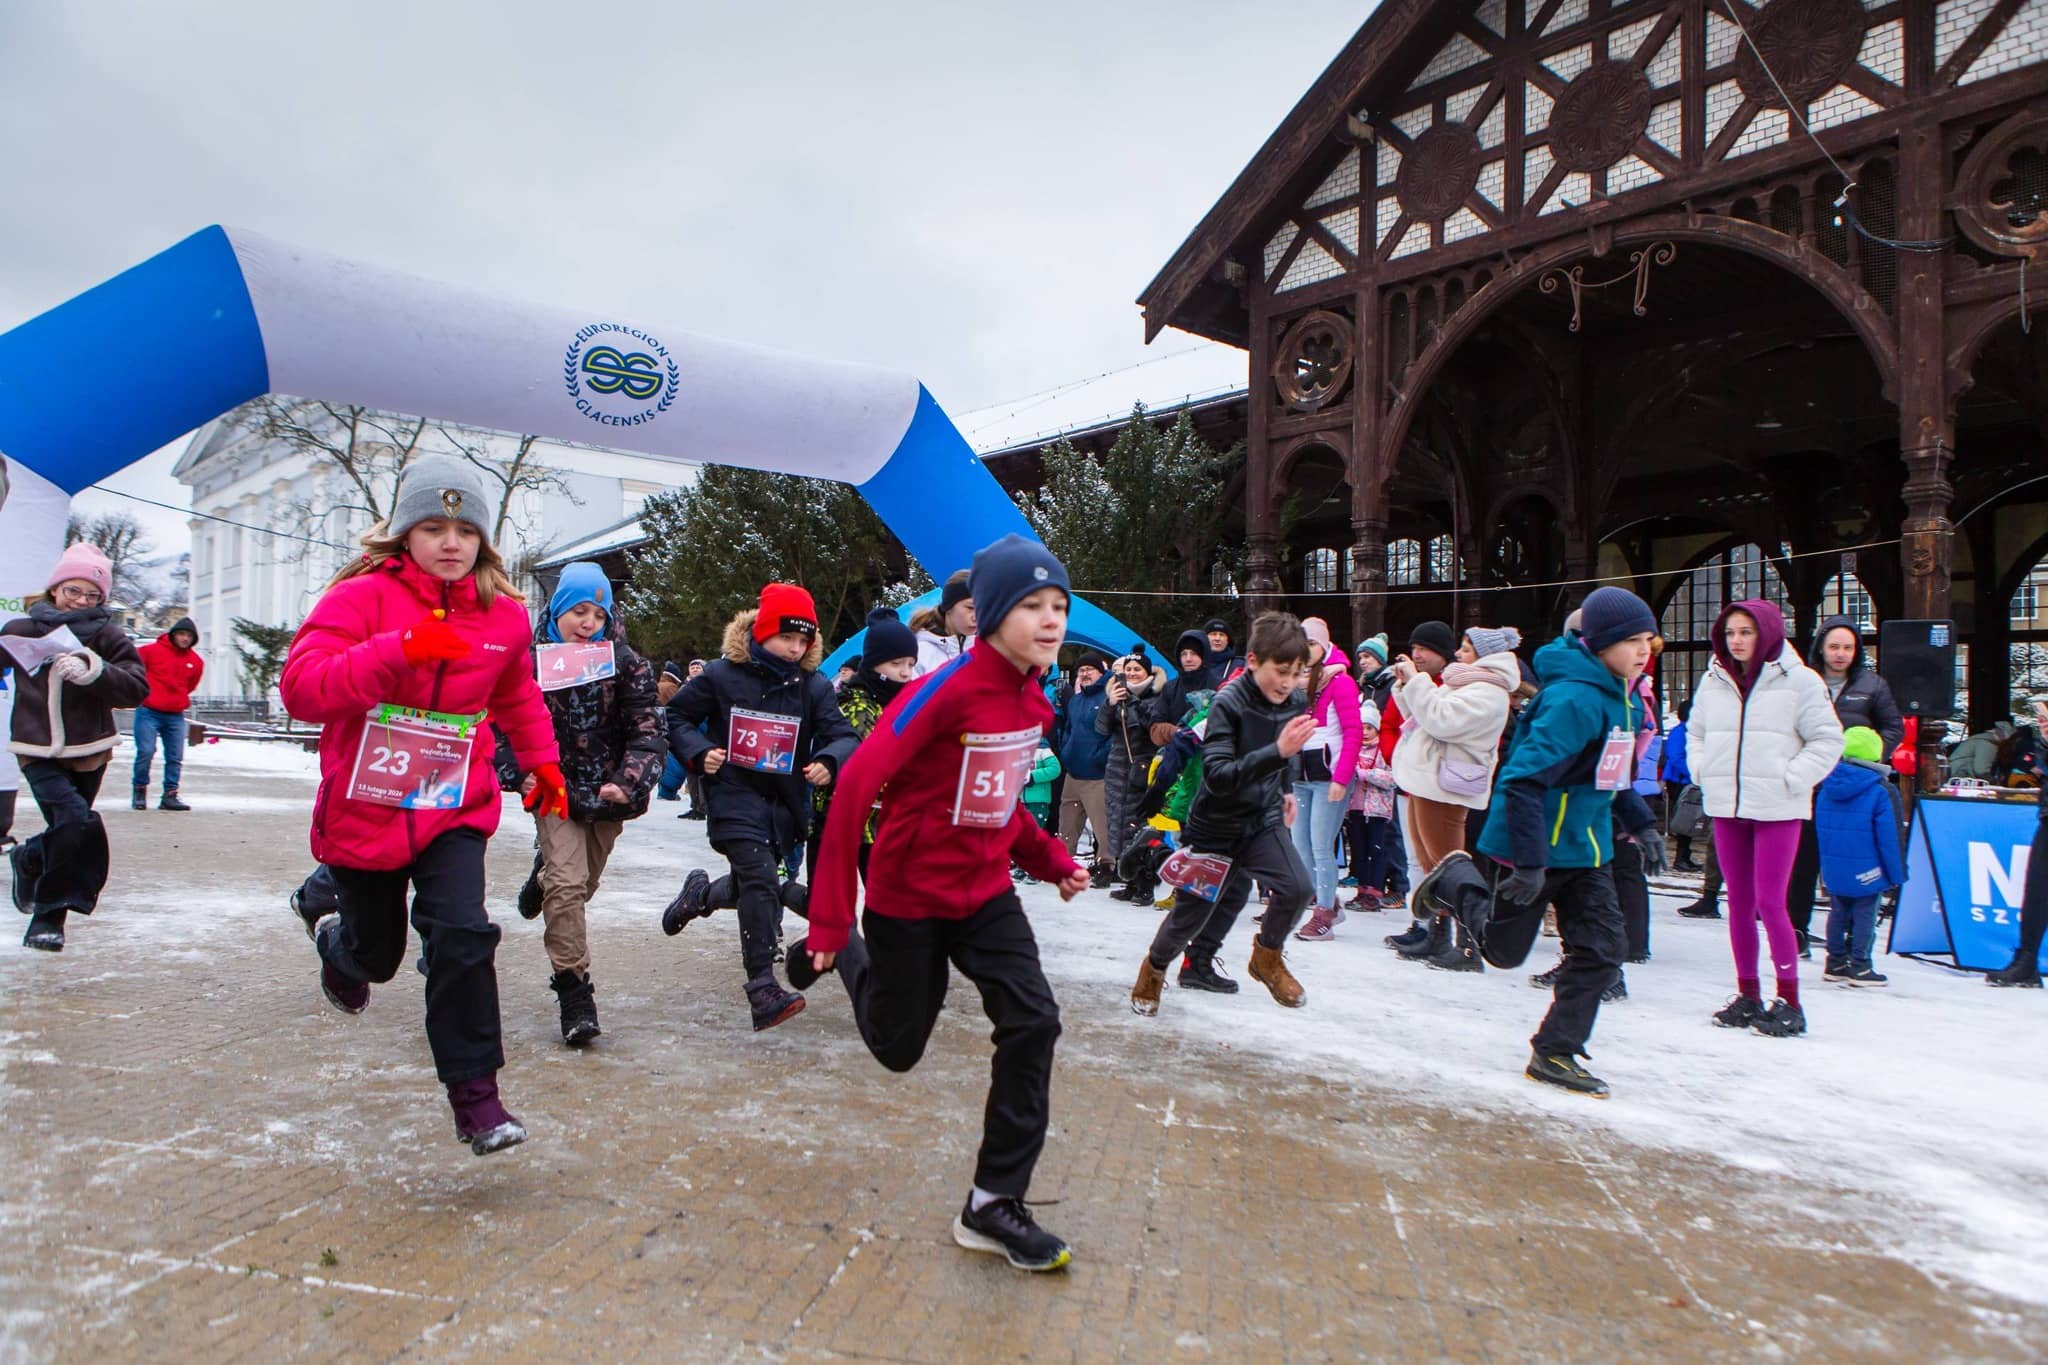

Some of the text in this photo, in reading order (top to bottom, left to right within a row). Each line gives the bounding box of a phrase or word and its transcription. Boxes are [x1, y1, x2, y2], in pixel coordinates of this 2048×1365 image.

[575, 323, 669, 357] EUROREGION
[575, 399, 656, 426] GLACENSIS
[552, 657, 566, 671] 4
[736, 728, 758, 748] 73
[368, 746, 411, 776] 23
[1603, 754, 1621, 771] 37
[972, 770, 1005, 797] 51
[1170, 860, 1191, 876] 67
